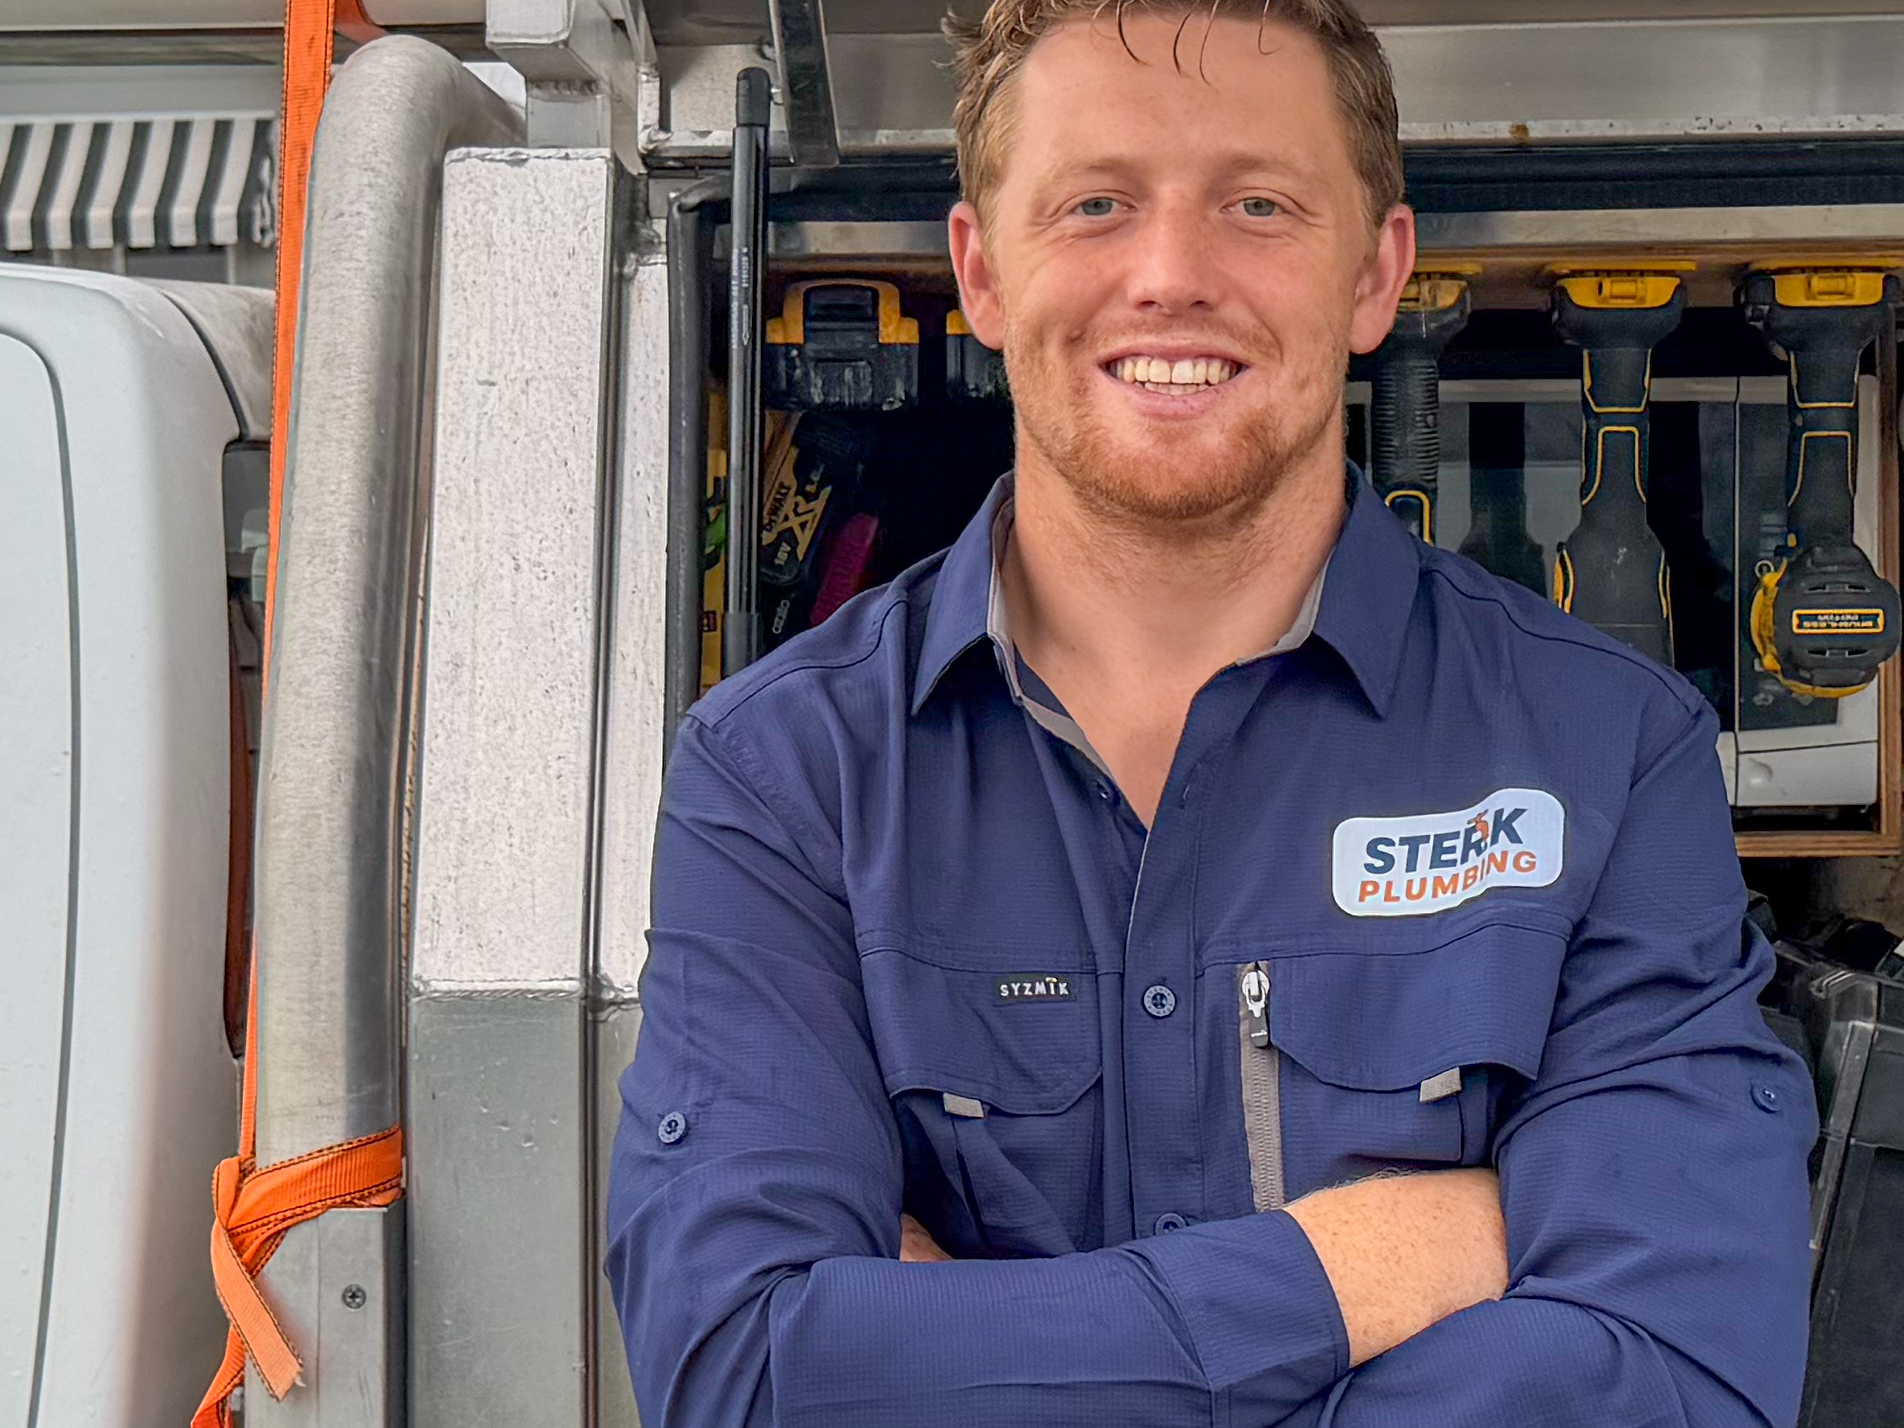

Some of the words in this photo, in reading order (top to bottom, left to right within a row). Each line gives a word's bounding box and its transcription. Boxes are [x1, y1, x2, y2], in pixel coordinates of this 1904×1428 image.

[1363, 808, 1528, 874] STERK
[1358, 850, 1537, 903] PLUMBING
[1000, 977, 1069, 997] SYZMIK
